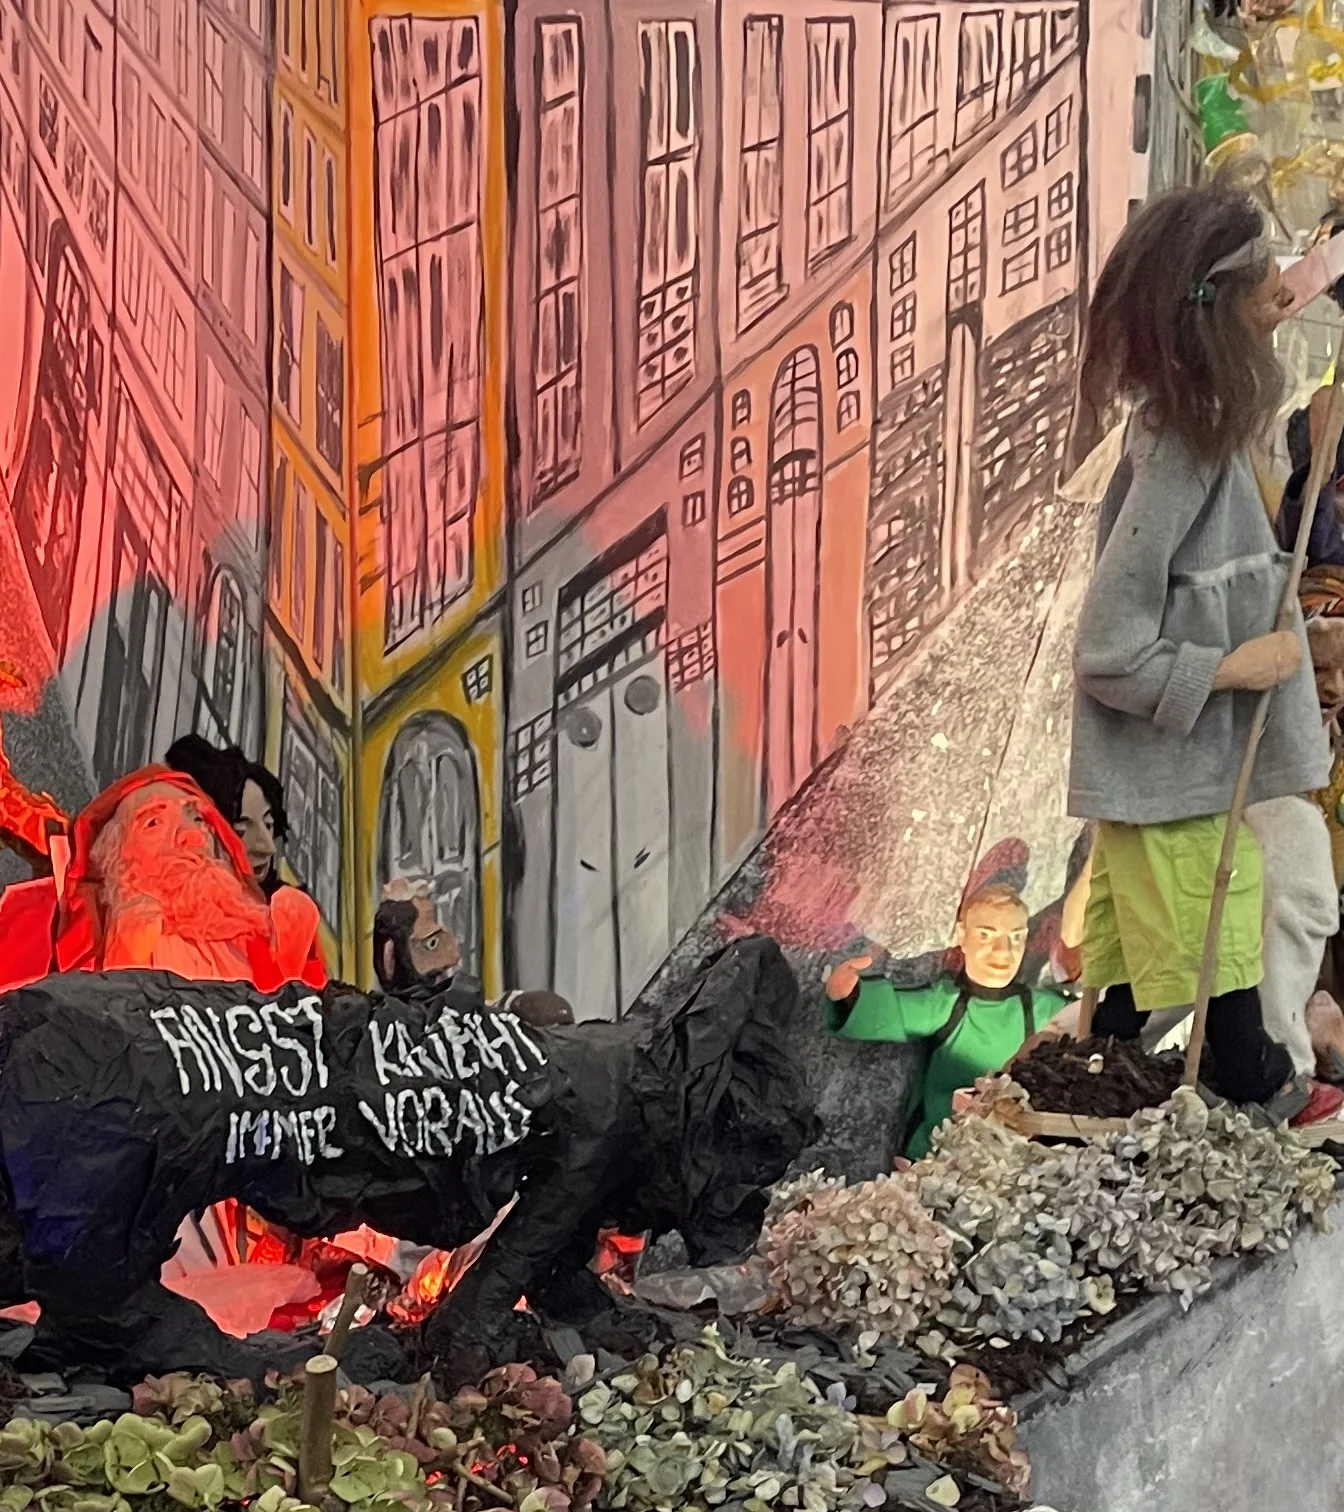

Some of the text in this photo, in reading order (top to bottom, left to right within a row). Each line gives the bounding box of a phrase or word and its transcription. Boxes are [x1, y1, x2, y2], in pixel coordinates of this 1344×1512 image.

[150, 996, 329, 1098] ANGST
[225, 1080, 533, 1165] IMMER VORAUS
